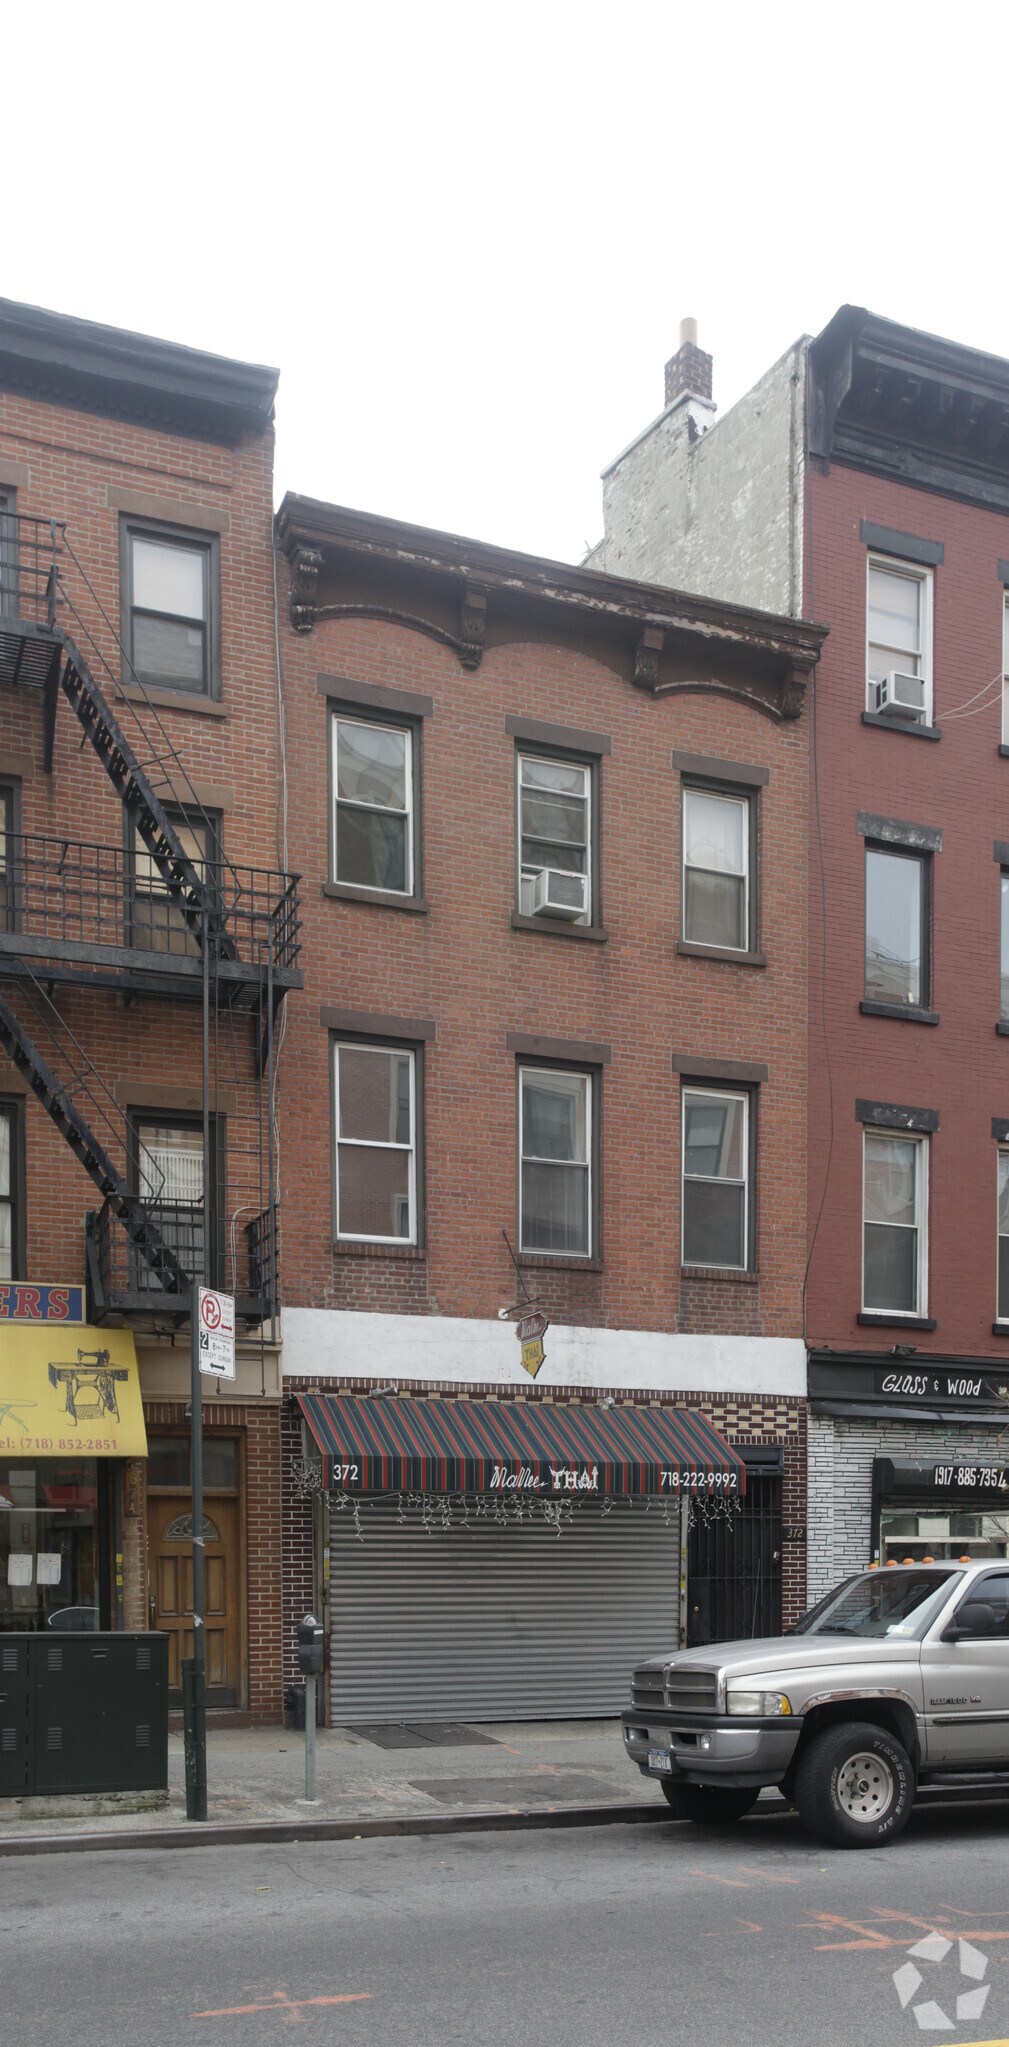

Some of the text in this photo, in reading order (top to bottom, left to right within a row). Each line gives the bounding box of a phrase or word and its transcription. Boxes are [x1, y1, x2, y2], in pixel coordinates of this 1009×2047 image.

[201, 1331, 208, 1348] 2
[202, 1350, 232, 1363] EXCEPT SUNDAY
[933, 1380, 939, 1391] &
[21, 1438, 53, 1450] (718)
[59, 1439, 117, 1450] 852-2851
[333, 1464, 359, 1480] 372
[549, 1465, 599, 1490] THAI
[660, 1471, 737, 1488] 718-222-9992
[786, 1528, 803, 1538] 372
